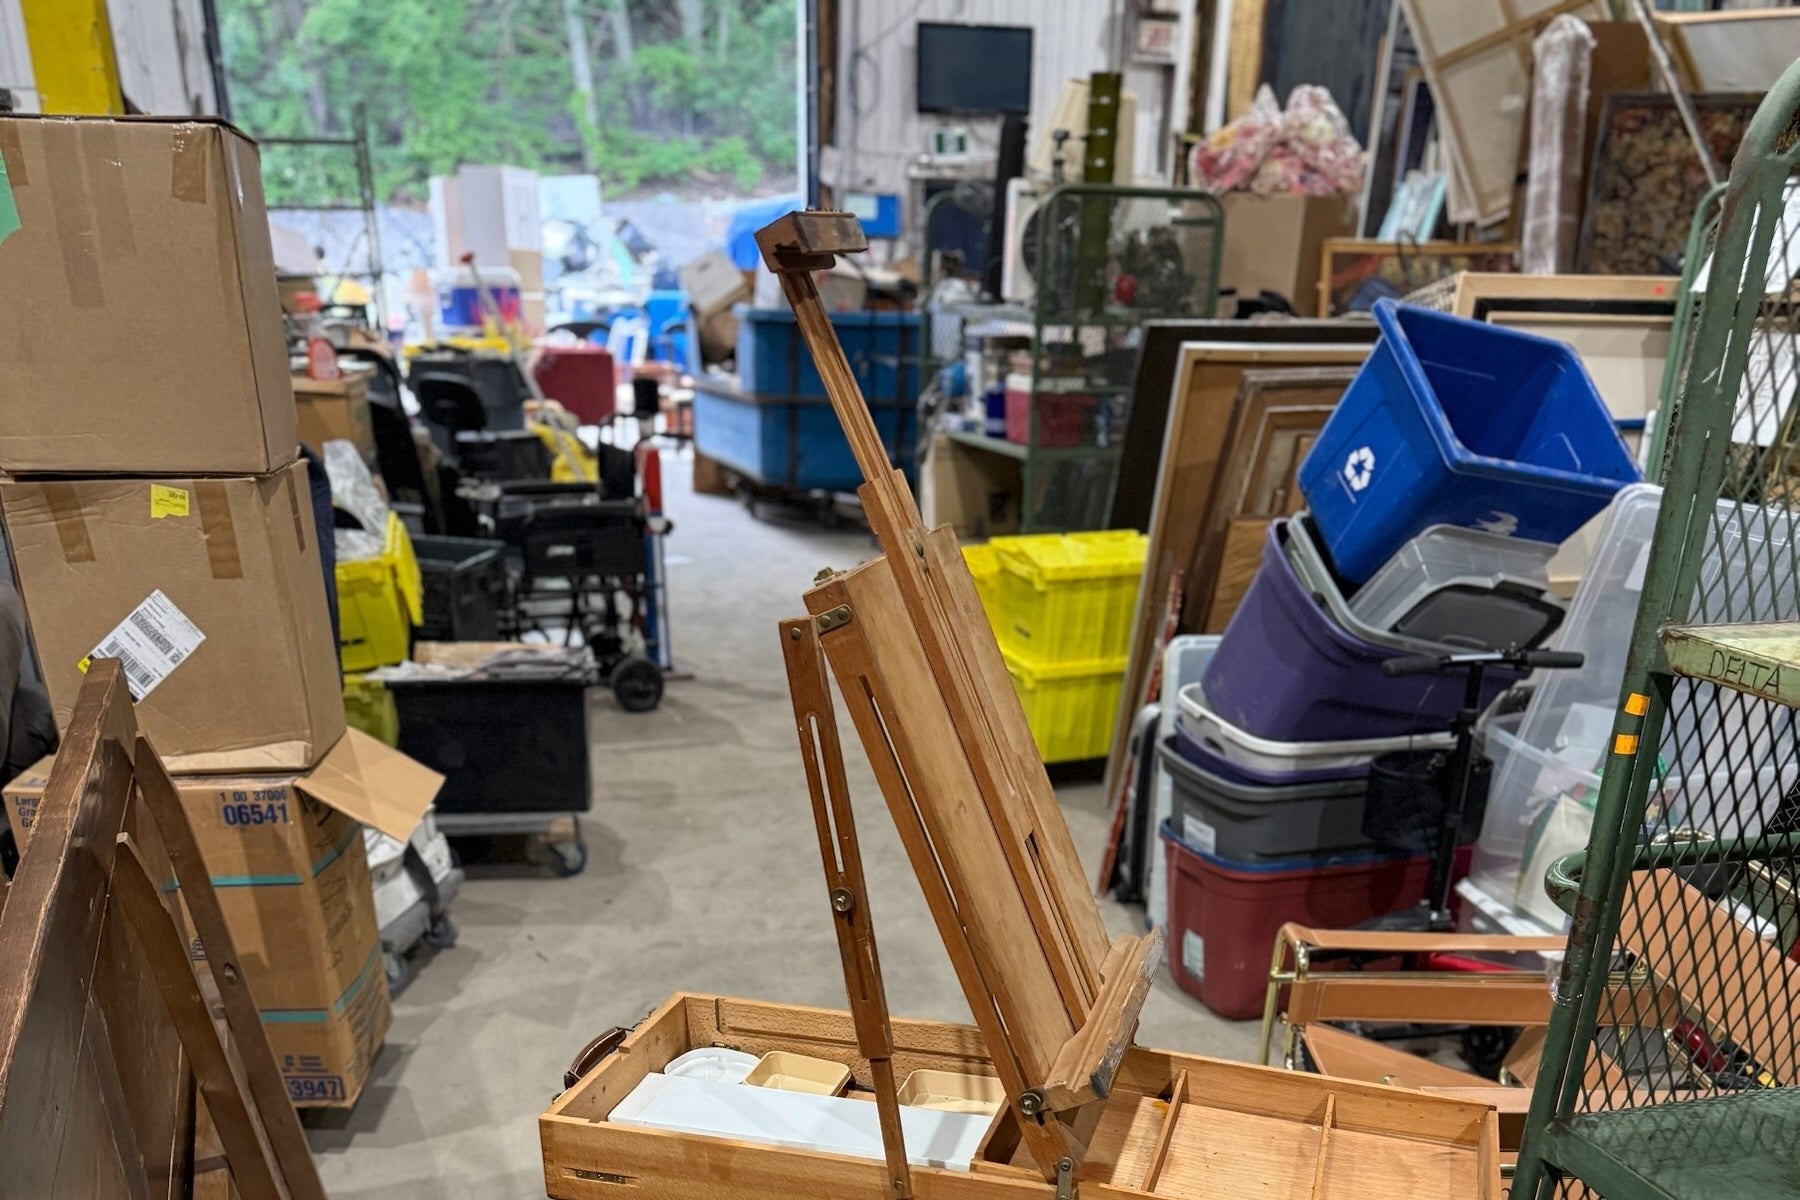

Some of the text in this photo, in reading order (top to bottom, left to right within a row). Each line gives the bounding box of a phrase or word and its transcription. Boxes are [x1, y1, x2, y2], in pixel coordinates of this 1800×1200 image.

[1708, 649, 1780, 695] DELTA
[219, 791, 226, 802] 1
[233, 791, 247, 802] 00
[223, 803, 288, 826] 06541
